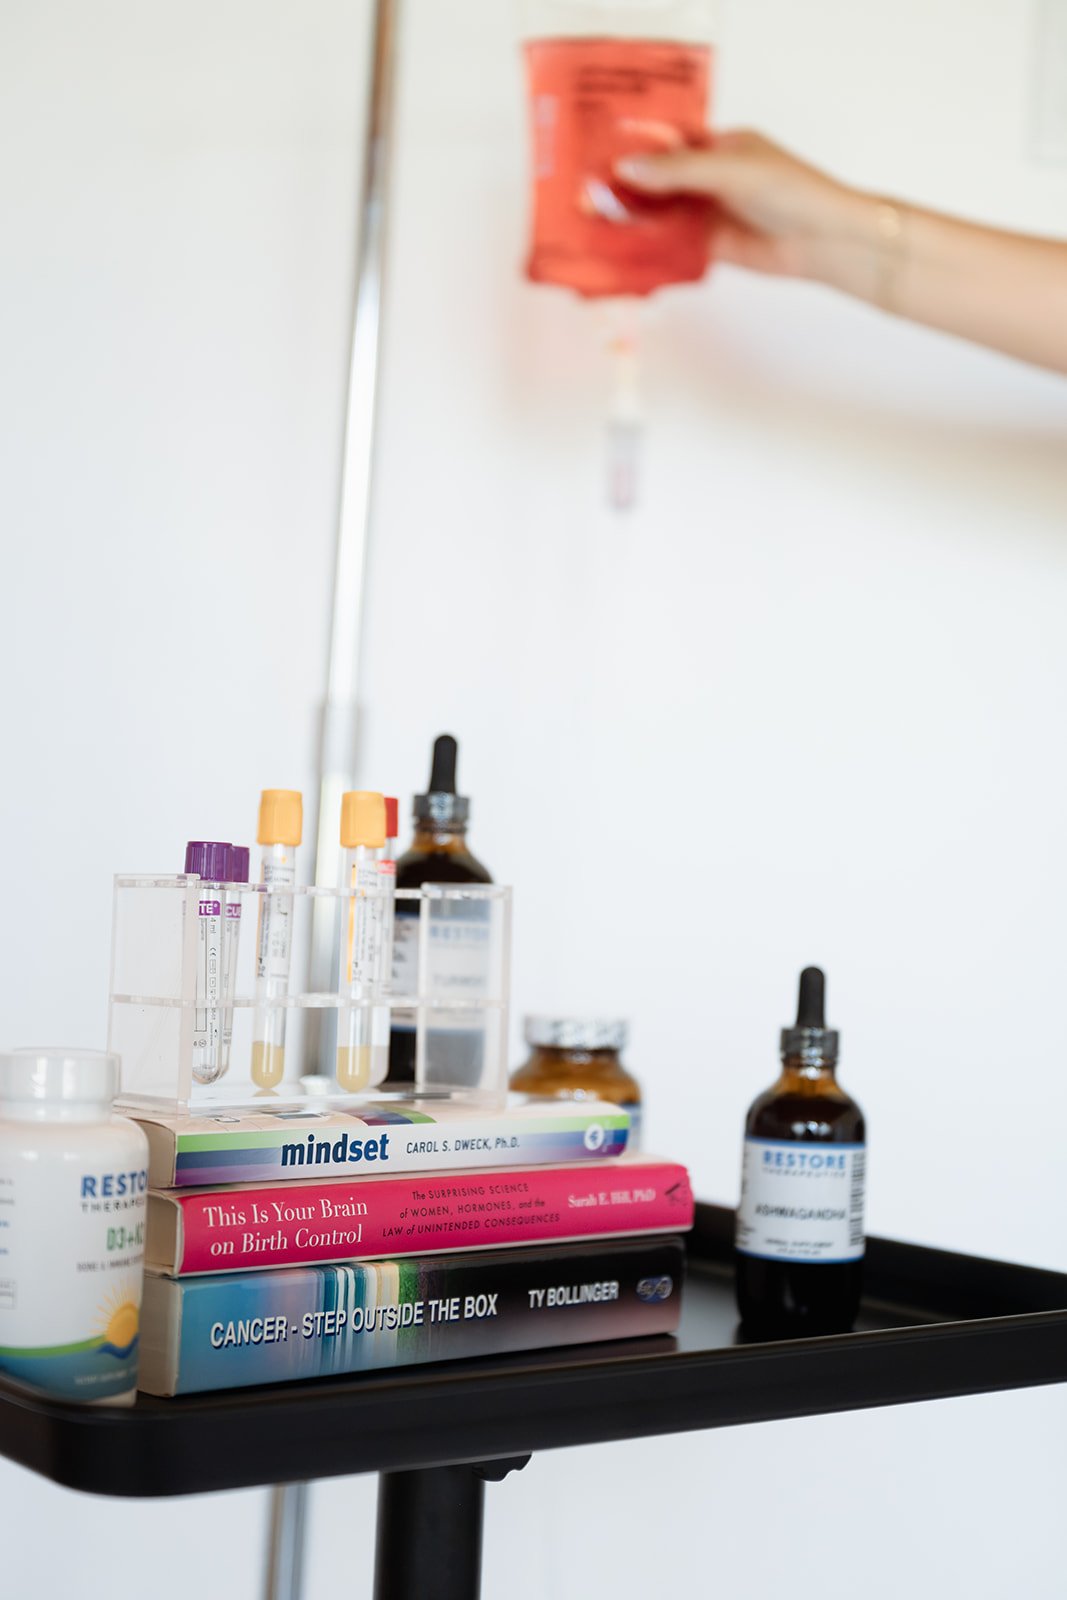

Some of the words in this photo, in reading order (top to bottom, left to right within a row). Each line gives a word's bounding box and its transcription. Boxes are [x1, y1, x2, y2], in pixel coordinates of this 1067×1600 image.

[281, 1134, 389, 1166] mindset
[406, 1141, 439, 1154] CAROL
[442, 1142, 451, 1153] S.
[454, 1138, 491, 1152] DWECK,
[495, 1137, 520, 1149] Ph.D.
[763, 1150, 846, 1169] RESTORE
[412, 1191, 426, 1200] The
[428, 1186, 485, 1200] SURPRISING
[489, 1183, 529, 1195] SCIENCE
[203, 1205, 246, 1227] This
[251, 1203, 269, 1224] Is
[270, 1202, 315, 1222] Your
[318, 1197, 368, 1219] Brain
[400, 1208, 408, 1219] of
[411, 1206, 453, 1217] WOMEN,
[457, 1201, 515, 1214] HORMONES,
[518, 1200, 532, 1209] and
[534, 1198, 545, 1207] the
[382, 1227, 403, 1237] LAW
[406, 1225, 416, 1235] of
[418, 1220, 480, 1234] UNINTENDED
[484, 1213, 561, 1228] CONSEQUENCES
[210, 1240, 235, 1256] on
[240, 1230, 288, 1254] Birth
[295, 1224, 363, 1249] Control
[528, 1289, 545, 1309] TY
[547, 1280, 619, 1307] BOLLINGER
[210, 1316, 288, 1349] CANCER
[301, 1309, 348, 1338] STEP
[351, 1301, 424, 1332] OUTSIDE
[428, 1298, 460, 1323] THE
[464, 1293, 498, 1319] BOX
